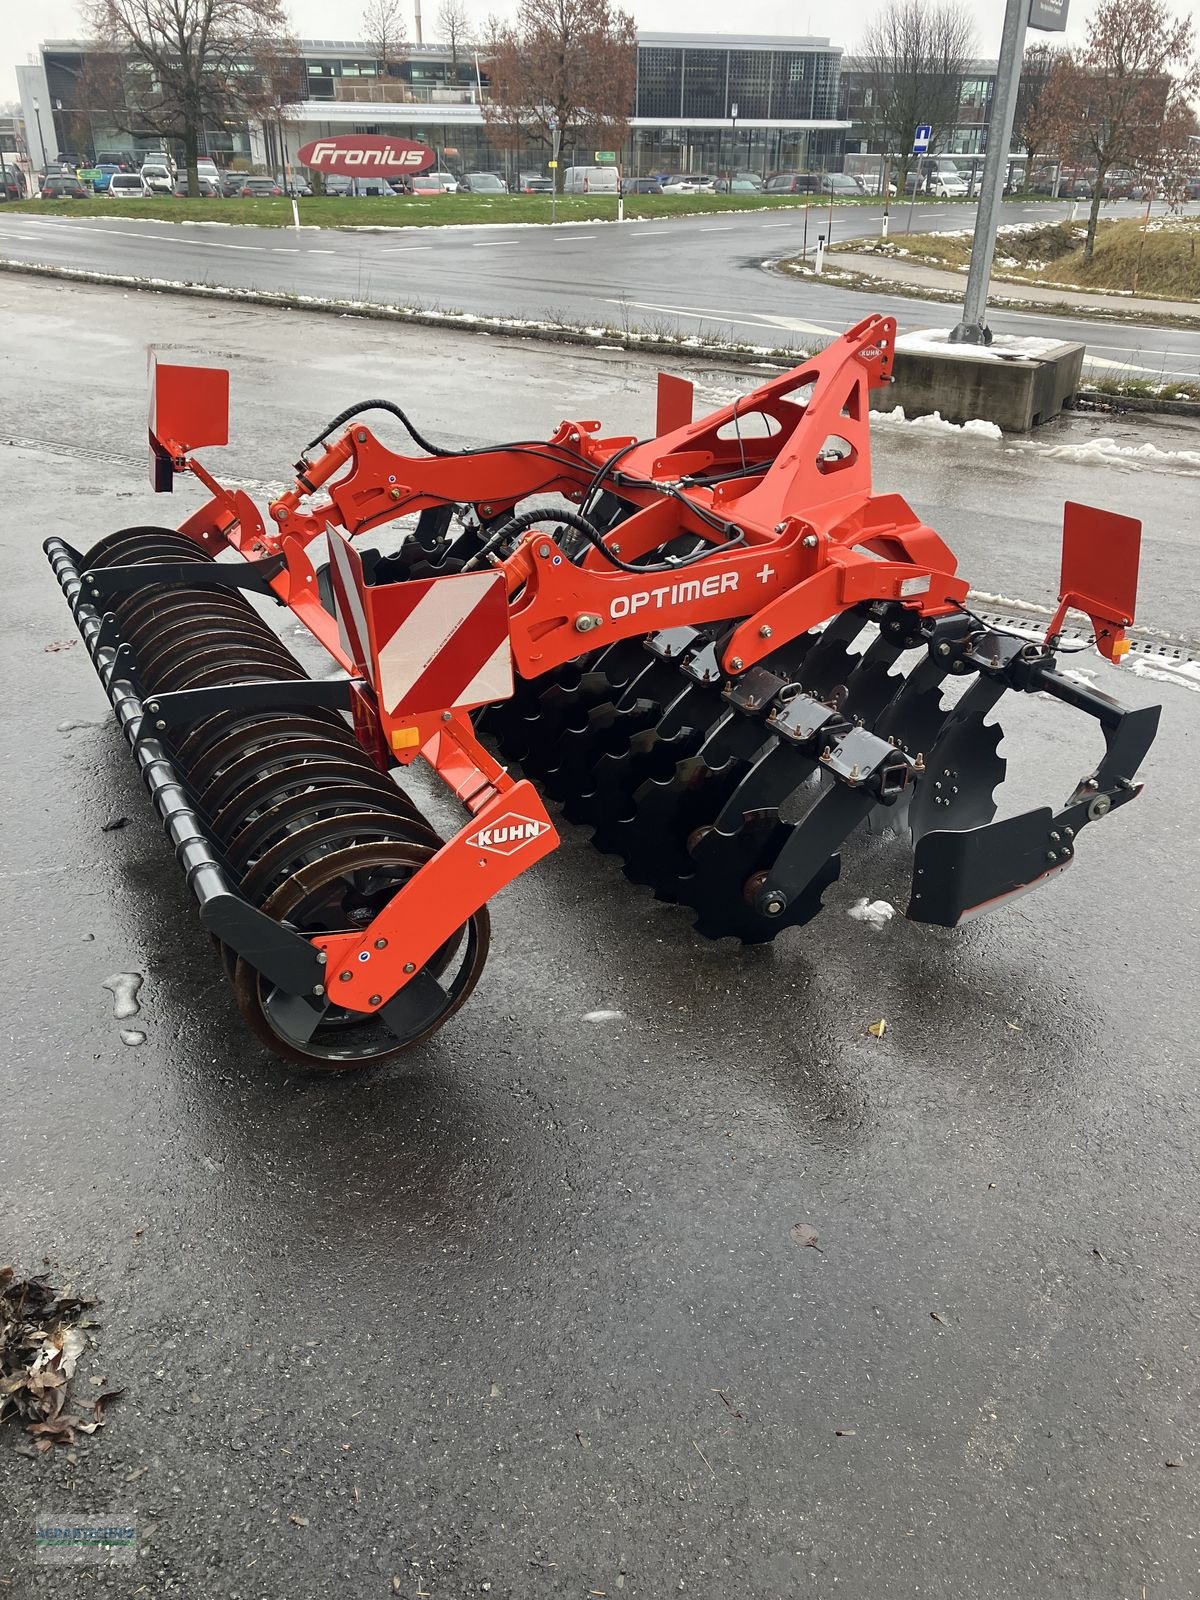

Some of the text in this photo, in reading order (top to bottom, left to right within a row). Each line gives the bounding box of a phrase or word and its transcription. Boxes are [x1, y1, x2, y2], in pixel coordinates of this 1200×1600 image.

[310, 143, 425, 165] Fronius
[610, 571, 739, 619] OPTIMER
[478, 822, 540, 847] KUHN
